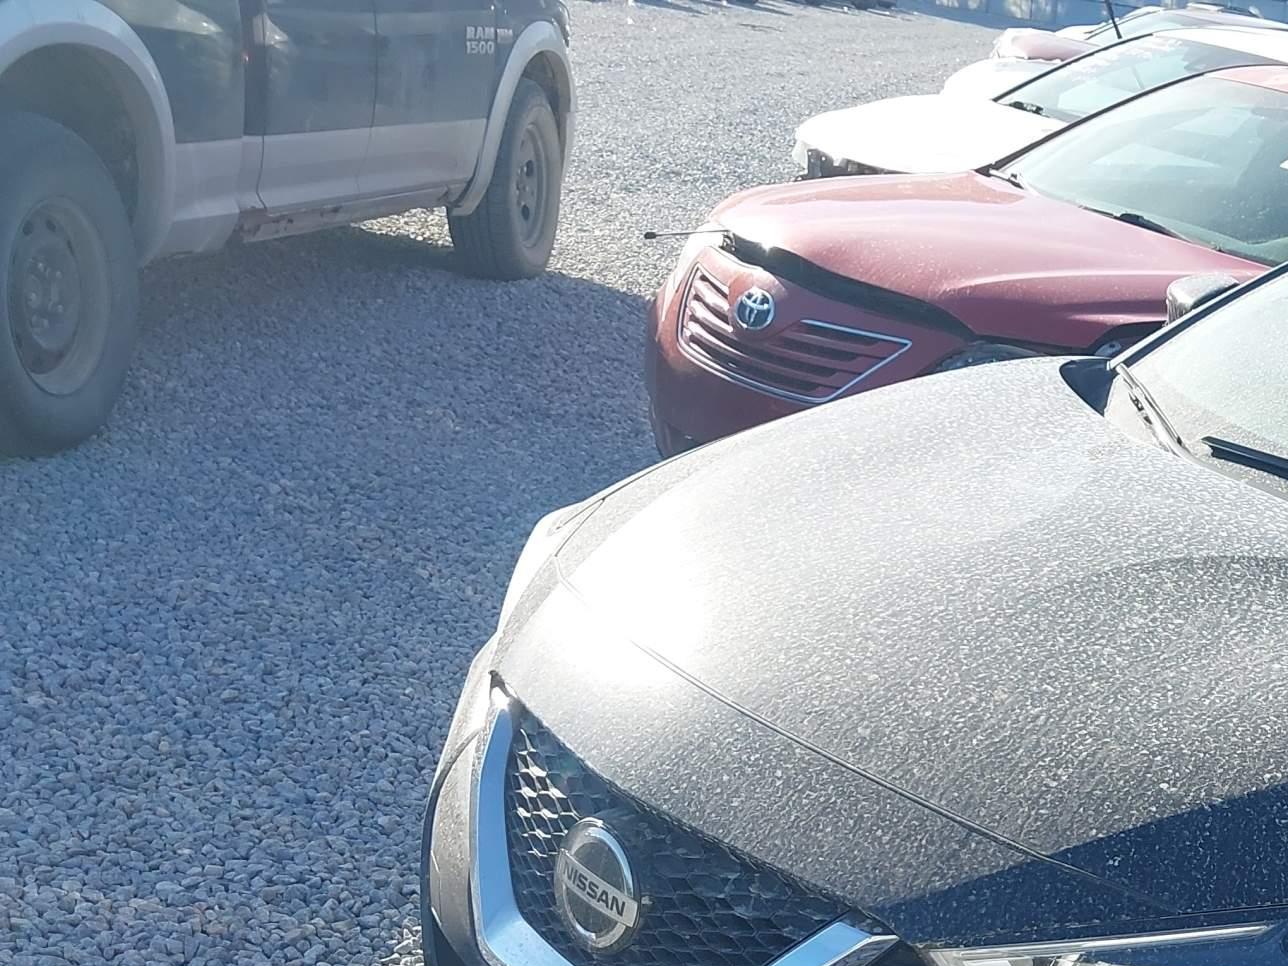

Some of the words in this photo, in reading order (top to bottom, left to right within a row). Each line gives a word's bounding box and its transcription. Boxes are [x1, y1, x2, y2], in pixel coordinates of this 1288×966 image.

[465, 25, 496, 40] RAM
[465, 41, 496, 55] 1500
[562, 860, 627, 917] NISSAN
